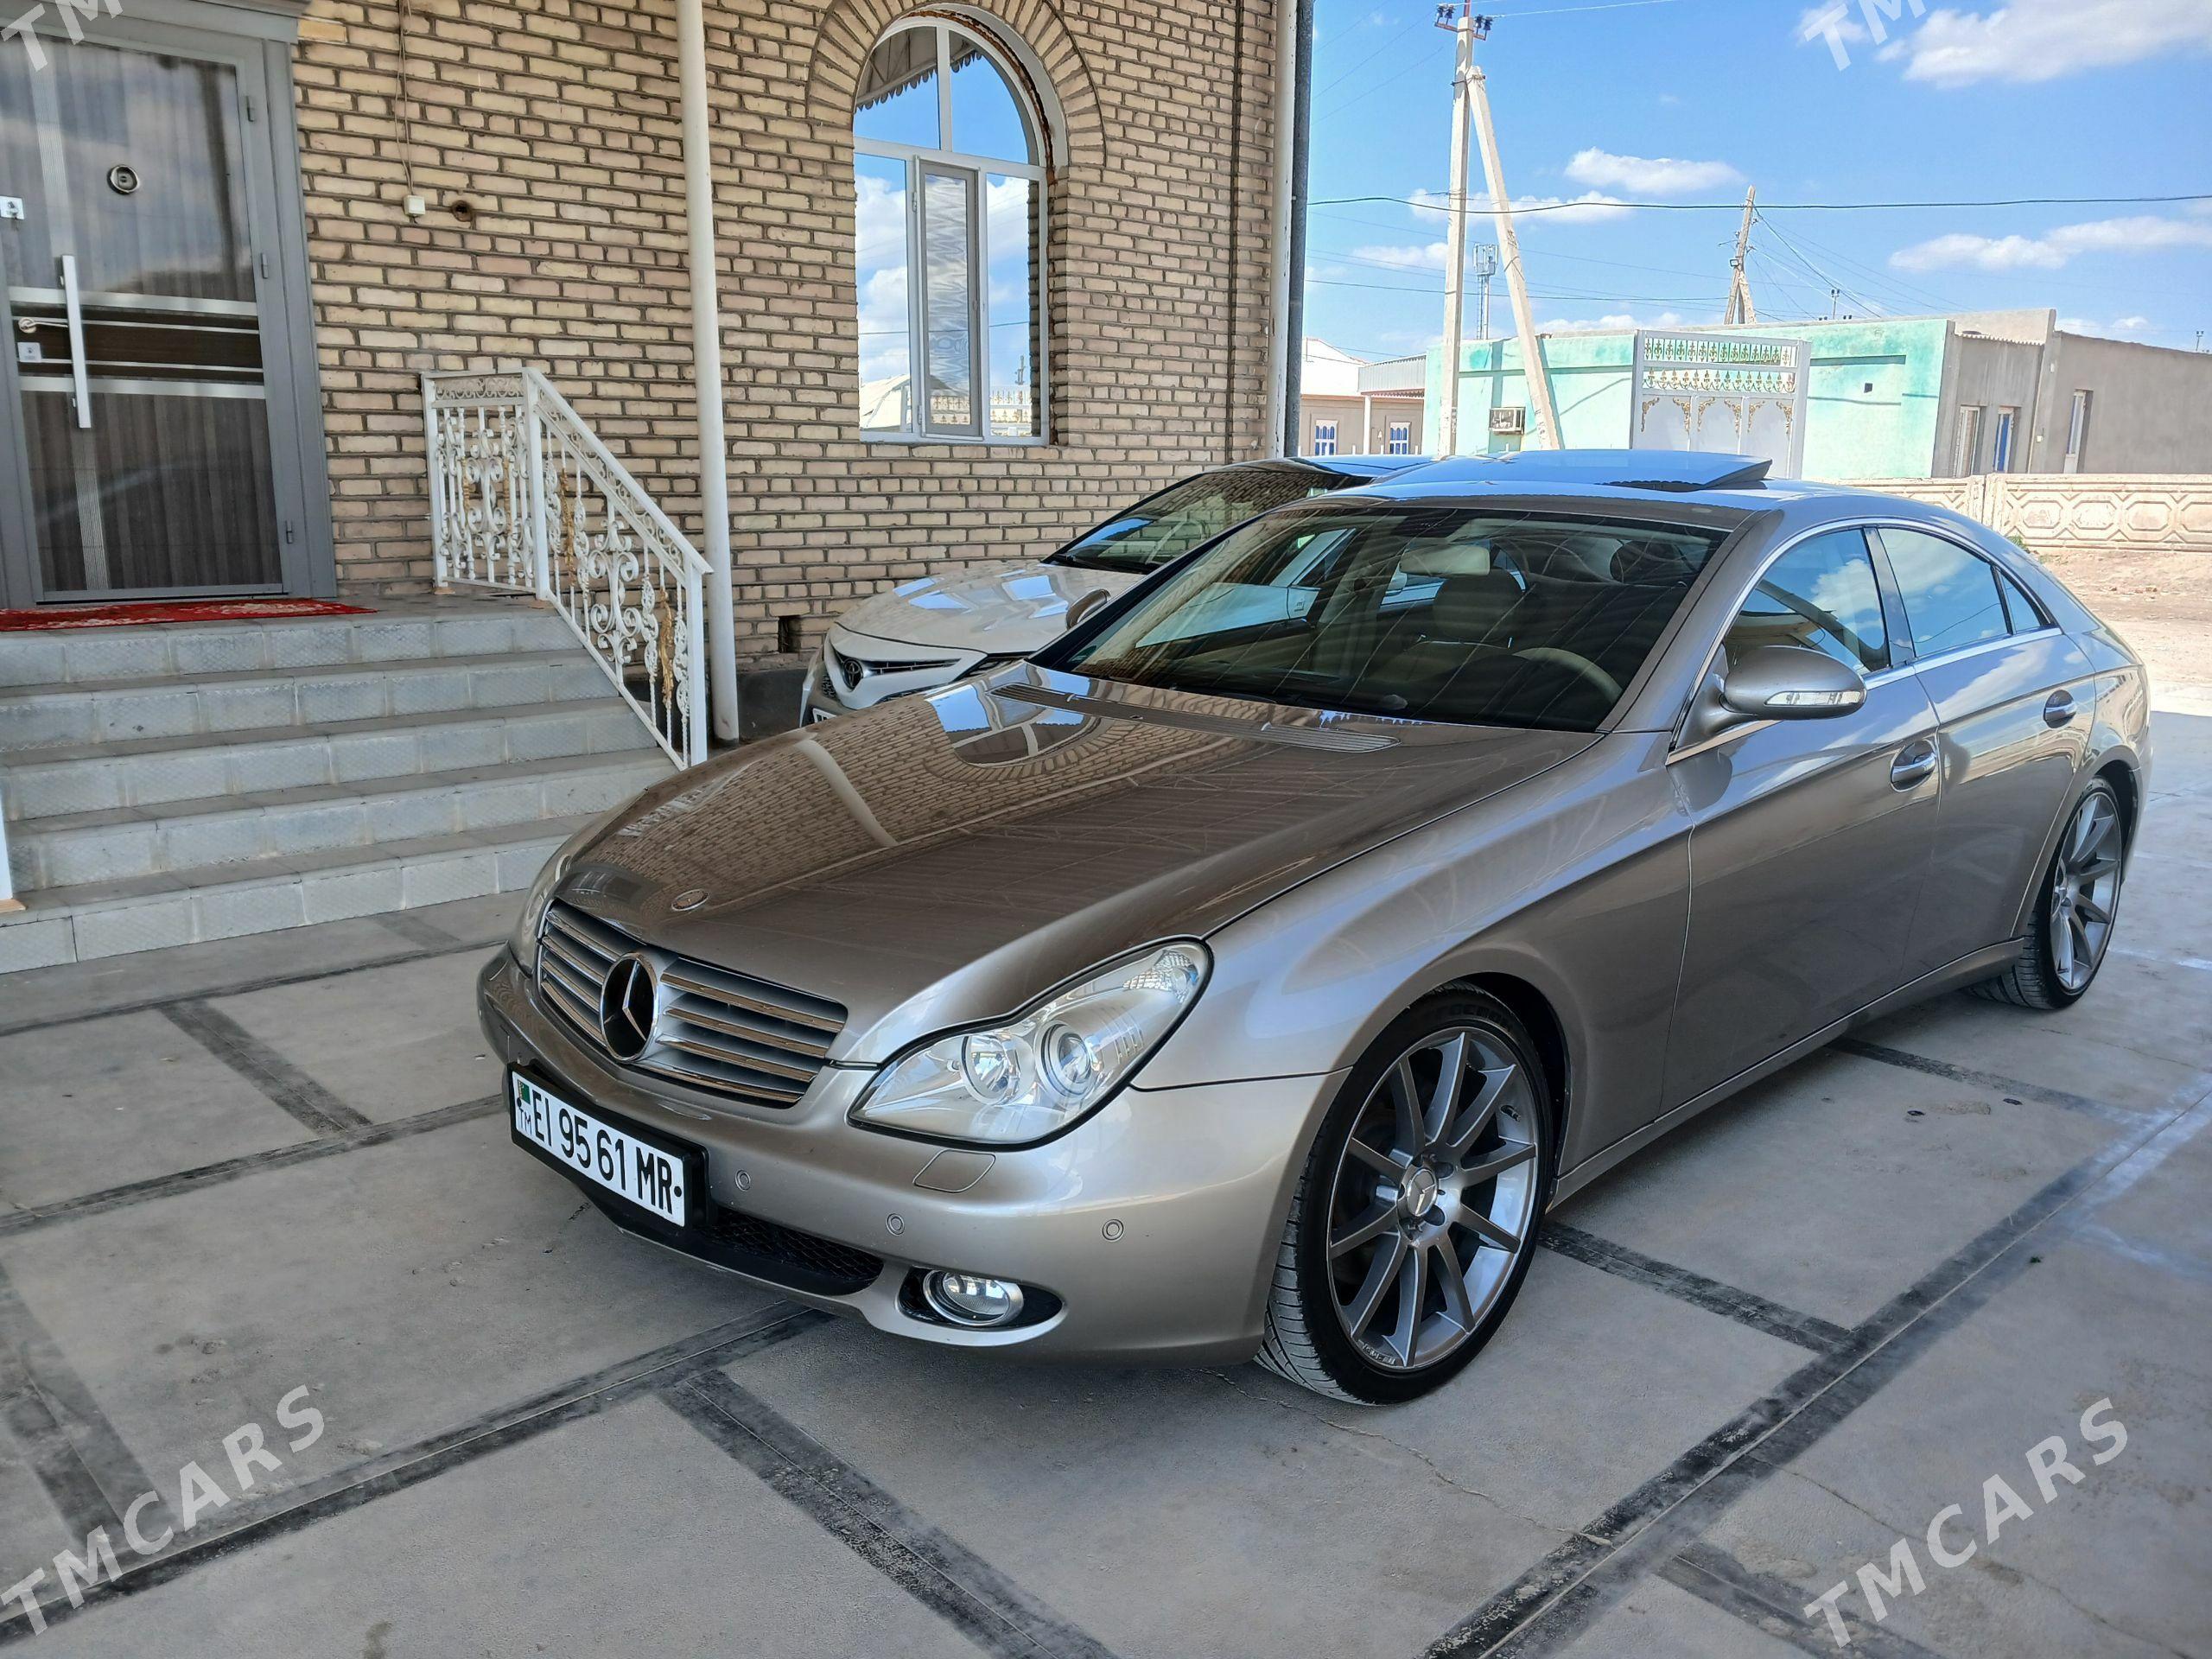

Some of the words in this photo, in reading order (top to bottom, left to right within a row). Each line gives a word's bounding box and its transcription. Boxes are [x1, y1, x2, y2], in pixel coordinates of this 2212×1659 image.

[519, 1107, 532, 1137] TM
[559, 1109, 626, 1191] 9561
[636, 1147, 673, 1215] MR
